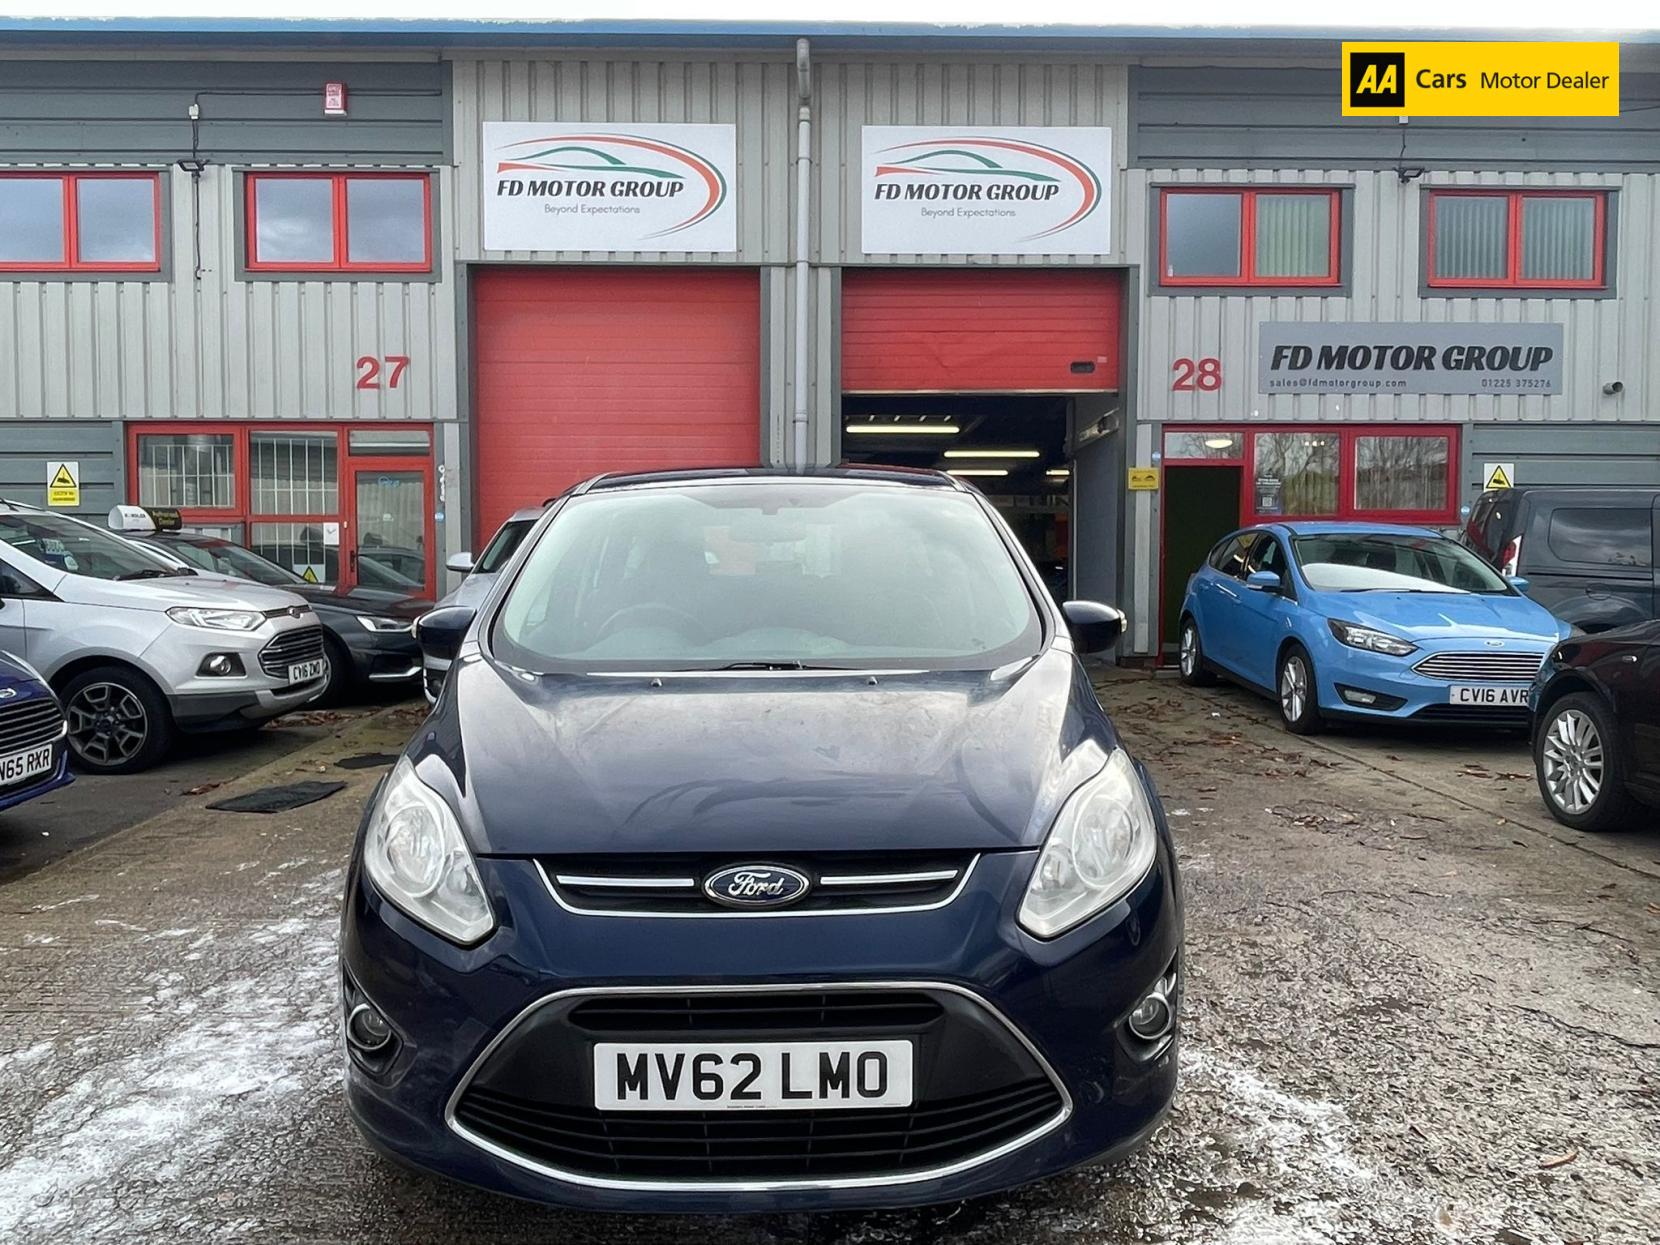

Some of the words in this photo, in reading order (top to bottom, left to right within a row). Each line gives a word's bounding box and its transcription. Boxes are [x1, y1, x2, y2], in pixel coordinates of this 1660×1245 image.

[497, 179, 524, 196] FD
[527, 180, 606, 197] MOTOR
[610, 180, 684, 198] GROUP
[874, 183, 901, 200] FD
[904, 183, 983, 200] MOTOR
[986, 184, 1060, 201] GROUP
[544, 203, 578, 216] Beyond
[581, 204, 641, 217] Expectations
[921, 207, 954, 219] Beyond
[957, 207, 1016, 219] Expectations
[1270, 345, 1313, 370] FD
[1316, 345, 1437, 371] MOTOR
[1441, 345, 1554, 372] GROUP
[356, 356, 409, 389] 27
[1172, 358, 1222, 391] 28
[1460, 687, 1496, 702] CV16
[1500, 688, 1529, 703] AVR
[27, 748, 50, 773] RXR
[728, 871, 785, 896] Ford
[616, 1052, 762, 1101] MV62
[781, 1051, 888, 1099] LMO
